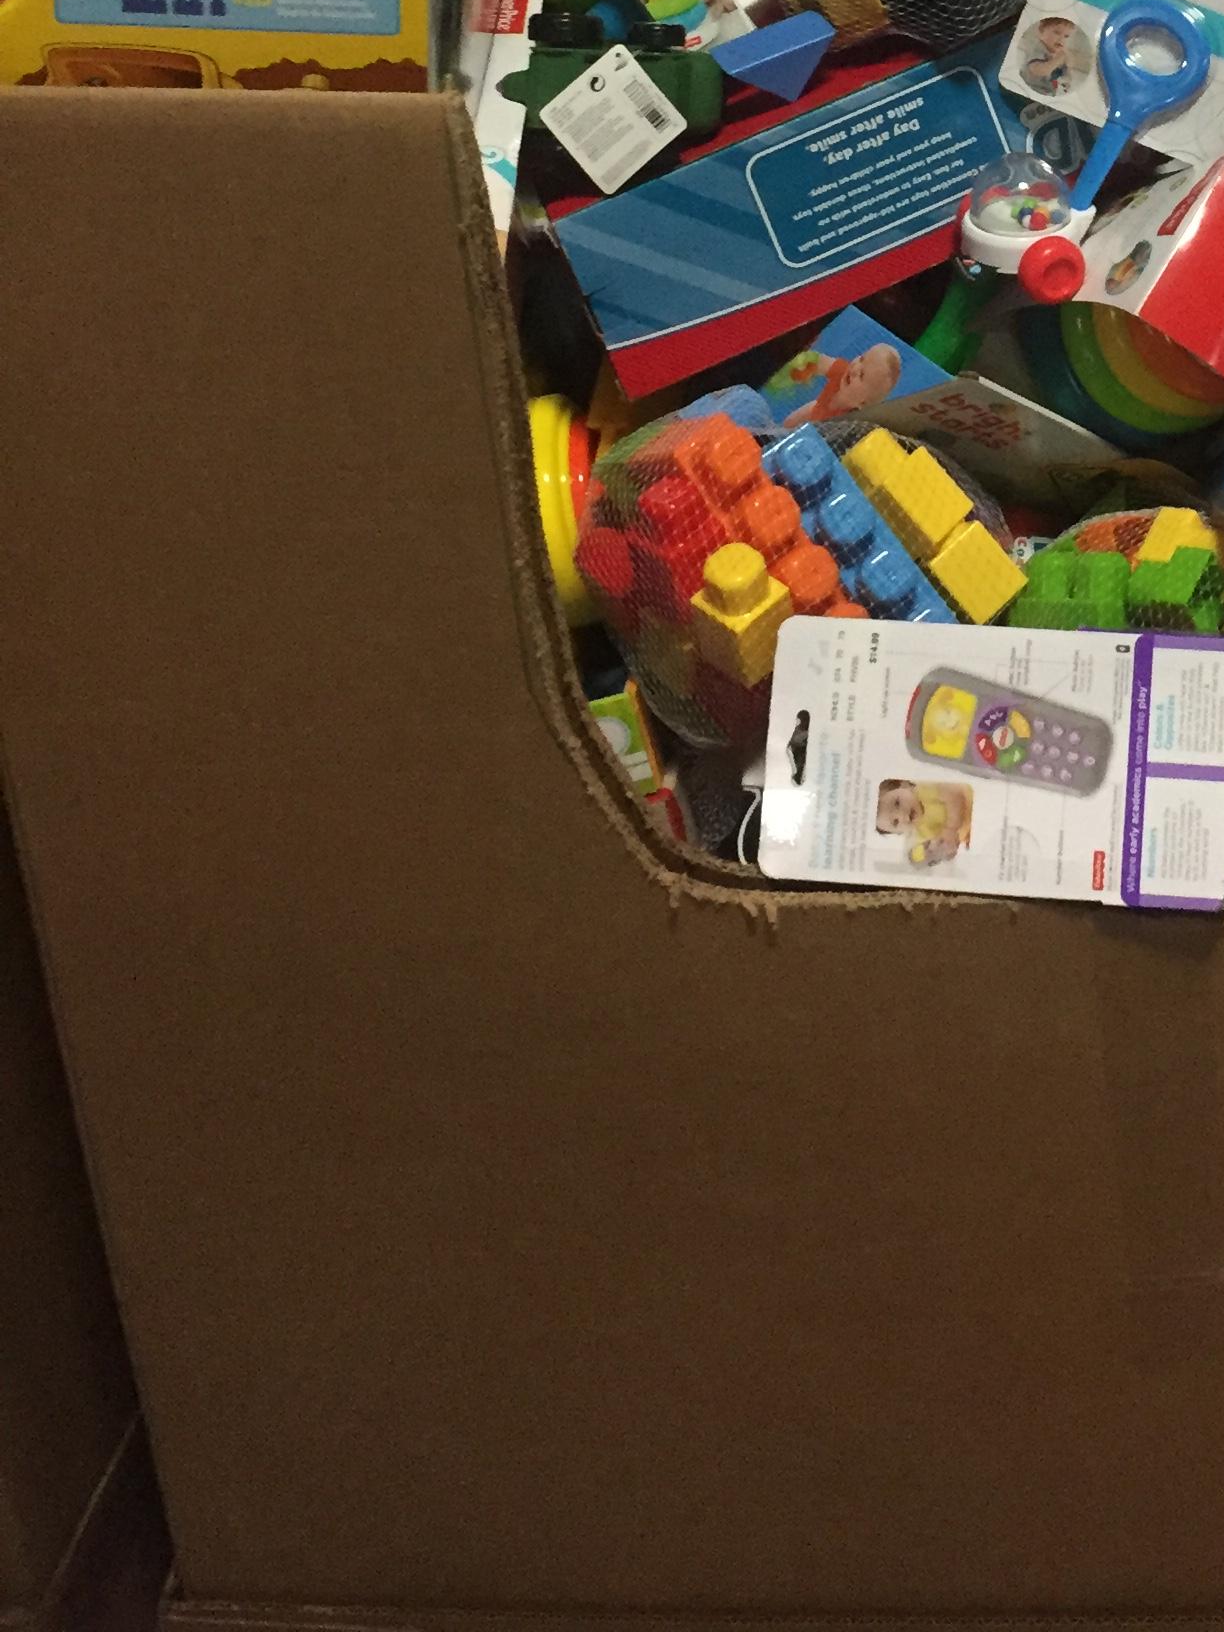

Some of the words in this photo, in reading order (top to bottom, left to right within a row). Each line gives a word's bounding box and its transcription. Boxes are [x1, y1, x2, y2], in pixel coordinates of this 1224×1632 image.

[887, 97, 924, 119] smile
[851, 114, 885, 136] after
[893, 119, 921, 137] Day
[805, 130, 848, 152] smile.
[857, 130, 890, 153] after
[823, 148, 854, 165] day,
[1134, 685, 1150, 710] play
[1133, 711, 1146, 732] into
[1132, 734, 1145, 765] come
[1128, 766, 1144, 825] academics
[1127, 825, 1143, 855] early
